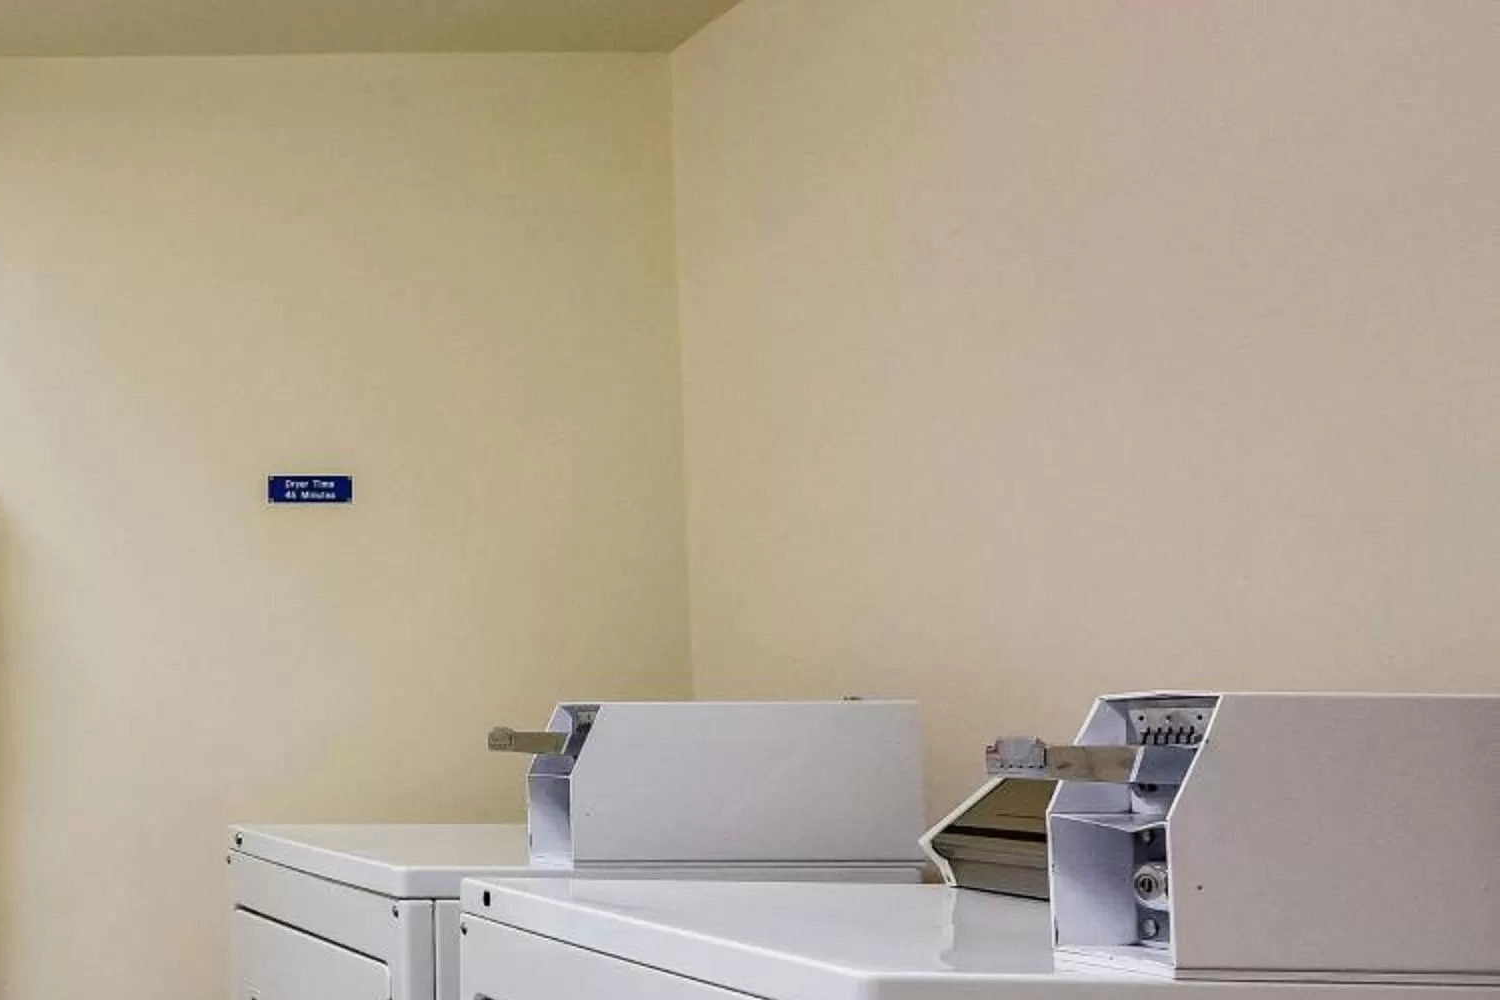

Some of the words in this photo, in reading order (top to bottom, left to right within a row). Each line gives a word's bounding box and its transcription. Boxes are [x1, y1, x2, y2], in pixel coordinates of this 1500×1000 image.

[285, 479, 309, 490] Dryer
[312, 479, 335, 489] Time
[301, 490, 336, 500] Minutes
